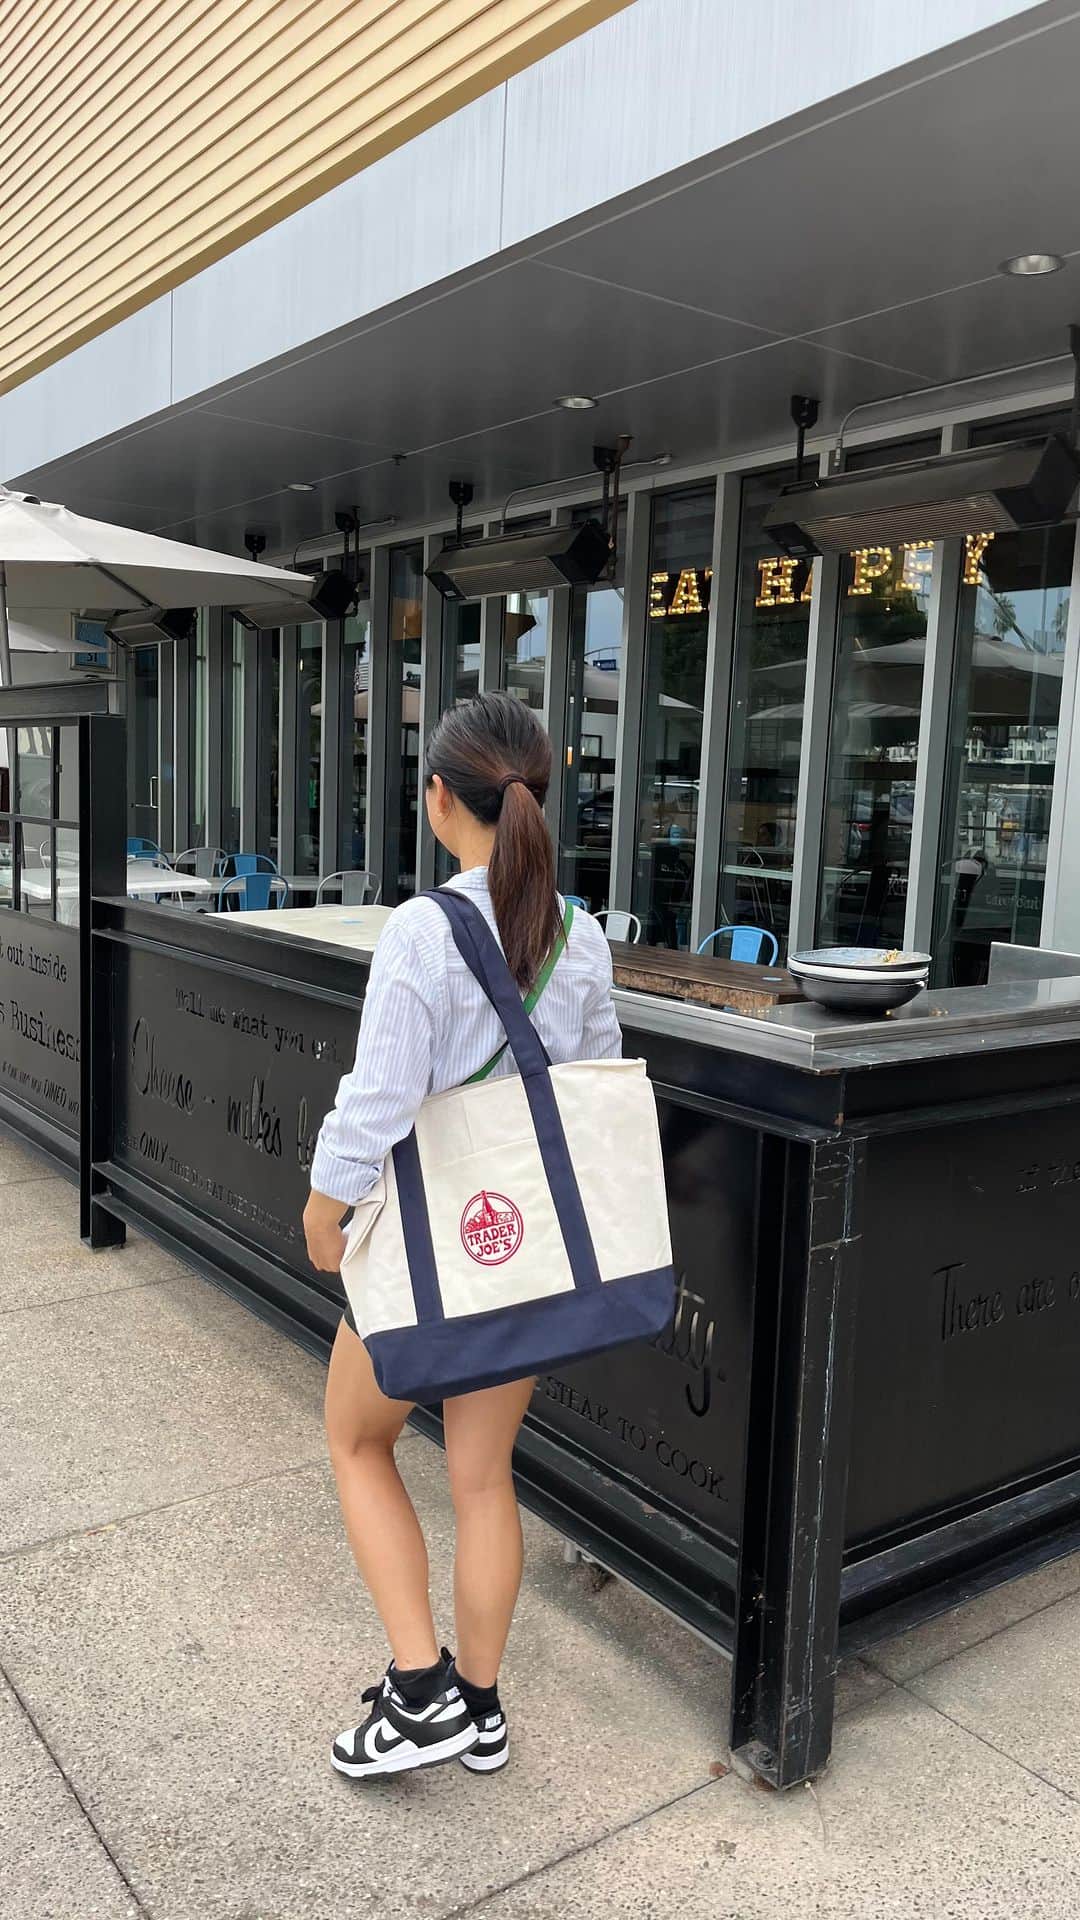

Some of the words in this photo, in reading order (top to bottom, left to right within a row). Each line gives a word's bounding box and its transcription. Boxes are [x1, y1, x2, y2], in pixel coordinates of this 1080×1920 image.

[648, 567, 714, 617] EA
[7, 943, 25, 967] out
[28, 946, 68, 983] inside
[232, 1008, 270, 1040] what
[139, 1131, 168, 1164] ONLY
[467, 1223, 516, 1246] TRADER
[477, 1238, 512, 1257] JOE'S
[930, 1257, 1005, 1342] There
[1016, 1275, 1056, 1318] are
[546, 1376, 611, 1433] STEAK
[618, 1416, 647, 1451] TO
[655, 1440, 729, 1502] COOK
